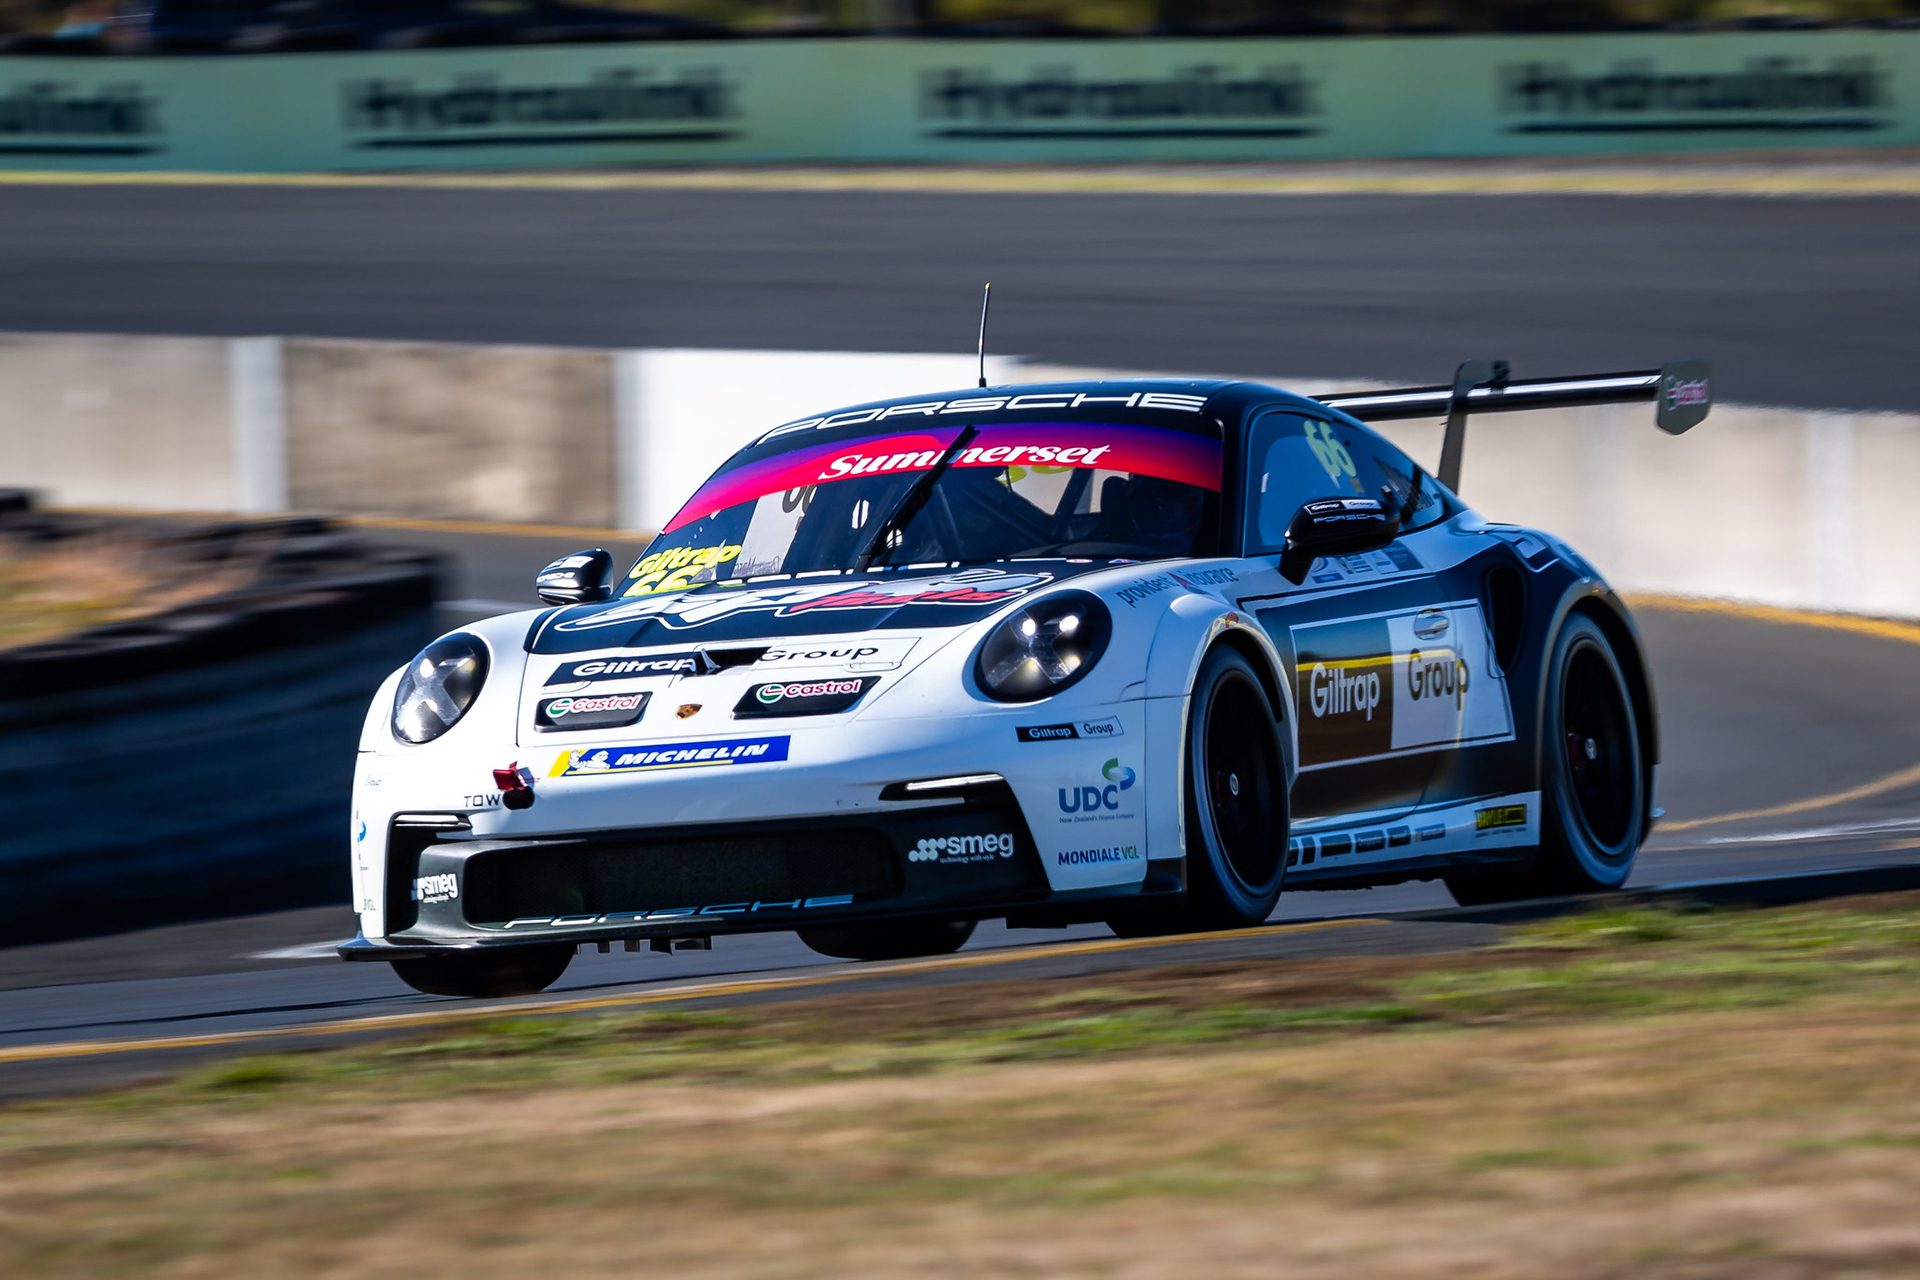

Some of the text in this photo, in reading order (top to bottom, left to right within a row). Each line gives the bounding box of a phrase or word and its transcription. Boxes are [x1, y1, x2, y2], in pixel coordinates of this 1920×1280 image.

[755, 393, 1208, 447] PORSCHE
[1304, 420, 1357, 477] 66
[628, 544, 742, 579] Giltrap
[573, 648, 879, 676] Giltrap Group
[784, 679, 862, 698] Castrol
[1310, 648, 1469, 721] Giltrap Group
[571, 694, 643, 713] Castrol
[1029, 723, 1114, 739] Giltrap Group
[615, 743, 770, 766] MICHELIN
[464, 794, 501, 808] TOW
[1058, 784, 1119, 813] UDC
[947, 833, 1013, 858] smeg
[1058, 845, 1140, 866] MONDIALE VGL
[423, 874, 458, 899] smeg
[504, 894, 854, 929] PORSCHE
